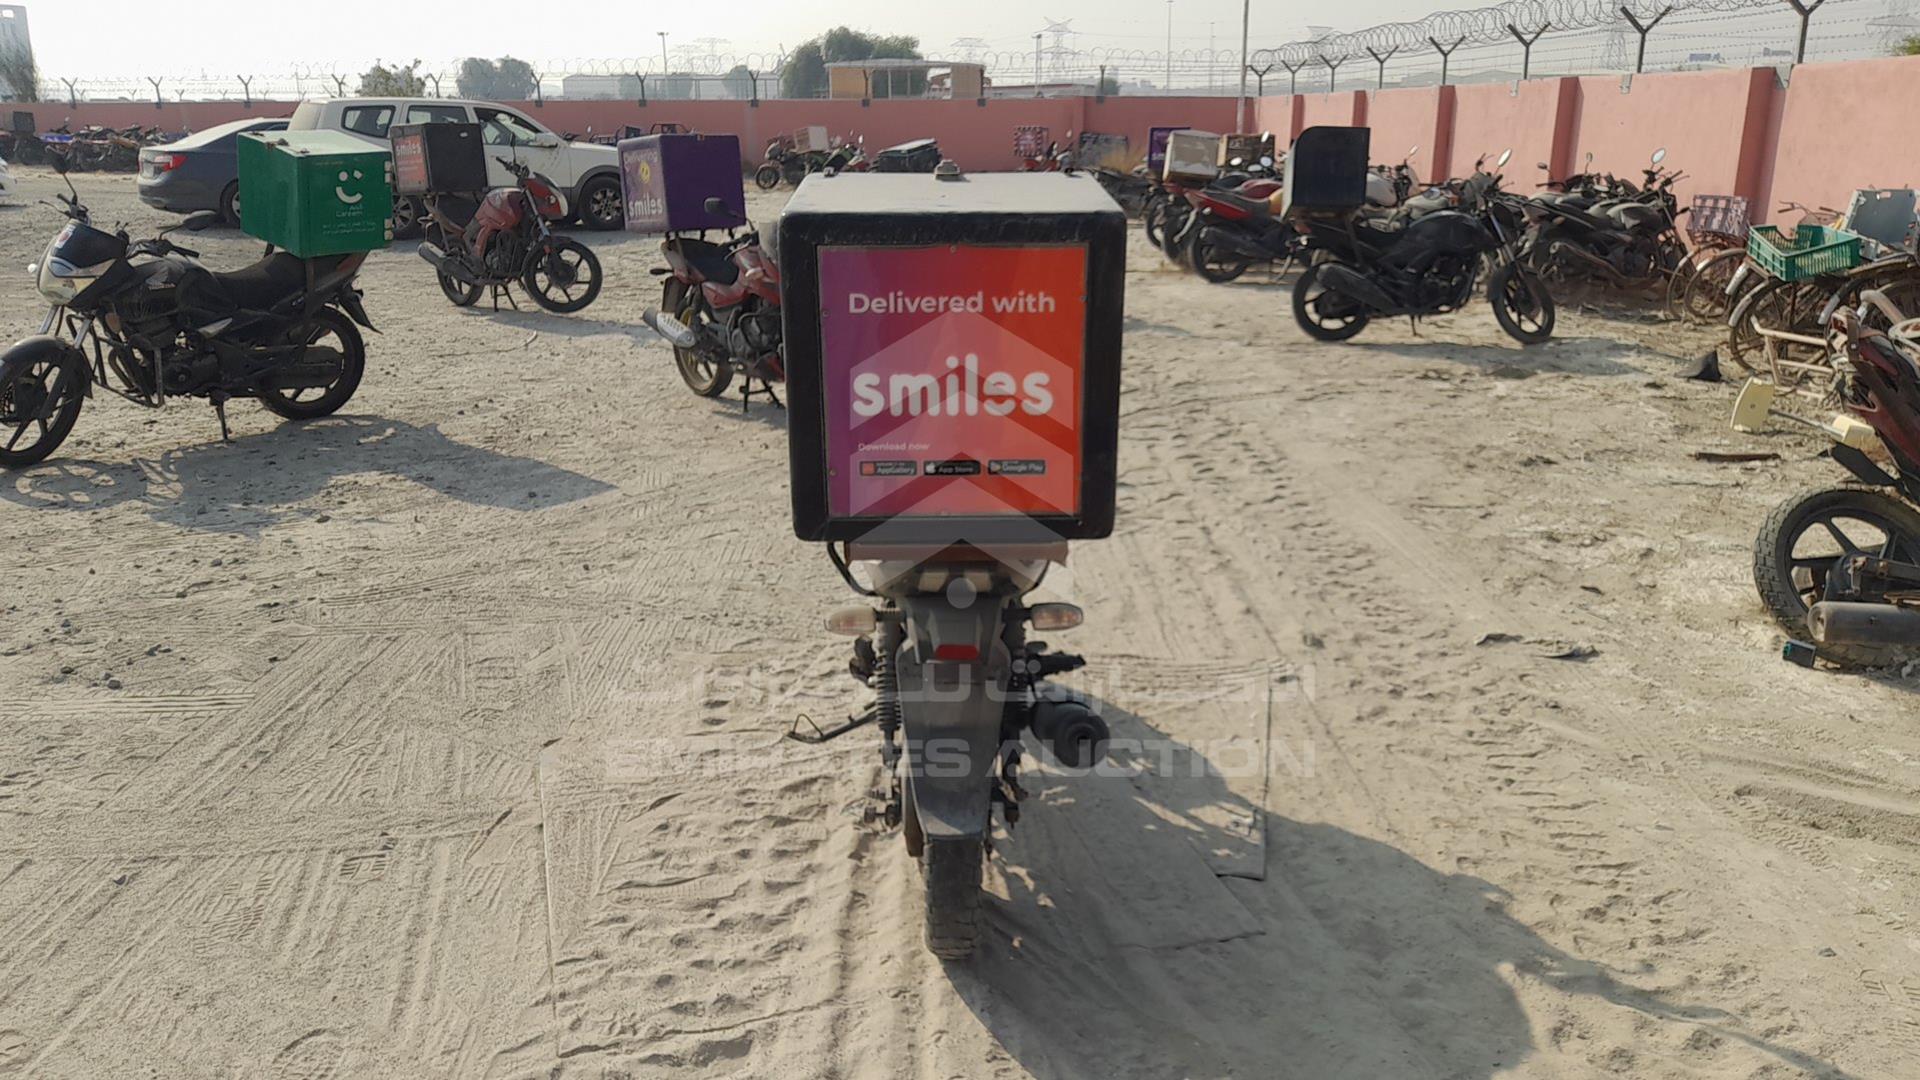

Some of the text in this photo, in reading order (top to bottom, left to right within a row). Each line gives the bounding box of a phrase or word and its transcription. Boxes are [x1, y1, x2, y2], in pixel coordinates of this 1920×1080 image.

[628, 192, 663, 216] smiles
[848, 291, 1056, 314] Delivered with
[852, 353, 1054, 417] smiles
[858, 442, 907, 451] Download
[939, 465, 974, 474] App Store
[1001, 462, 1044, 473] Google Play
